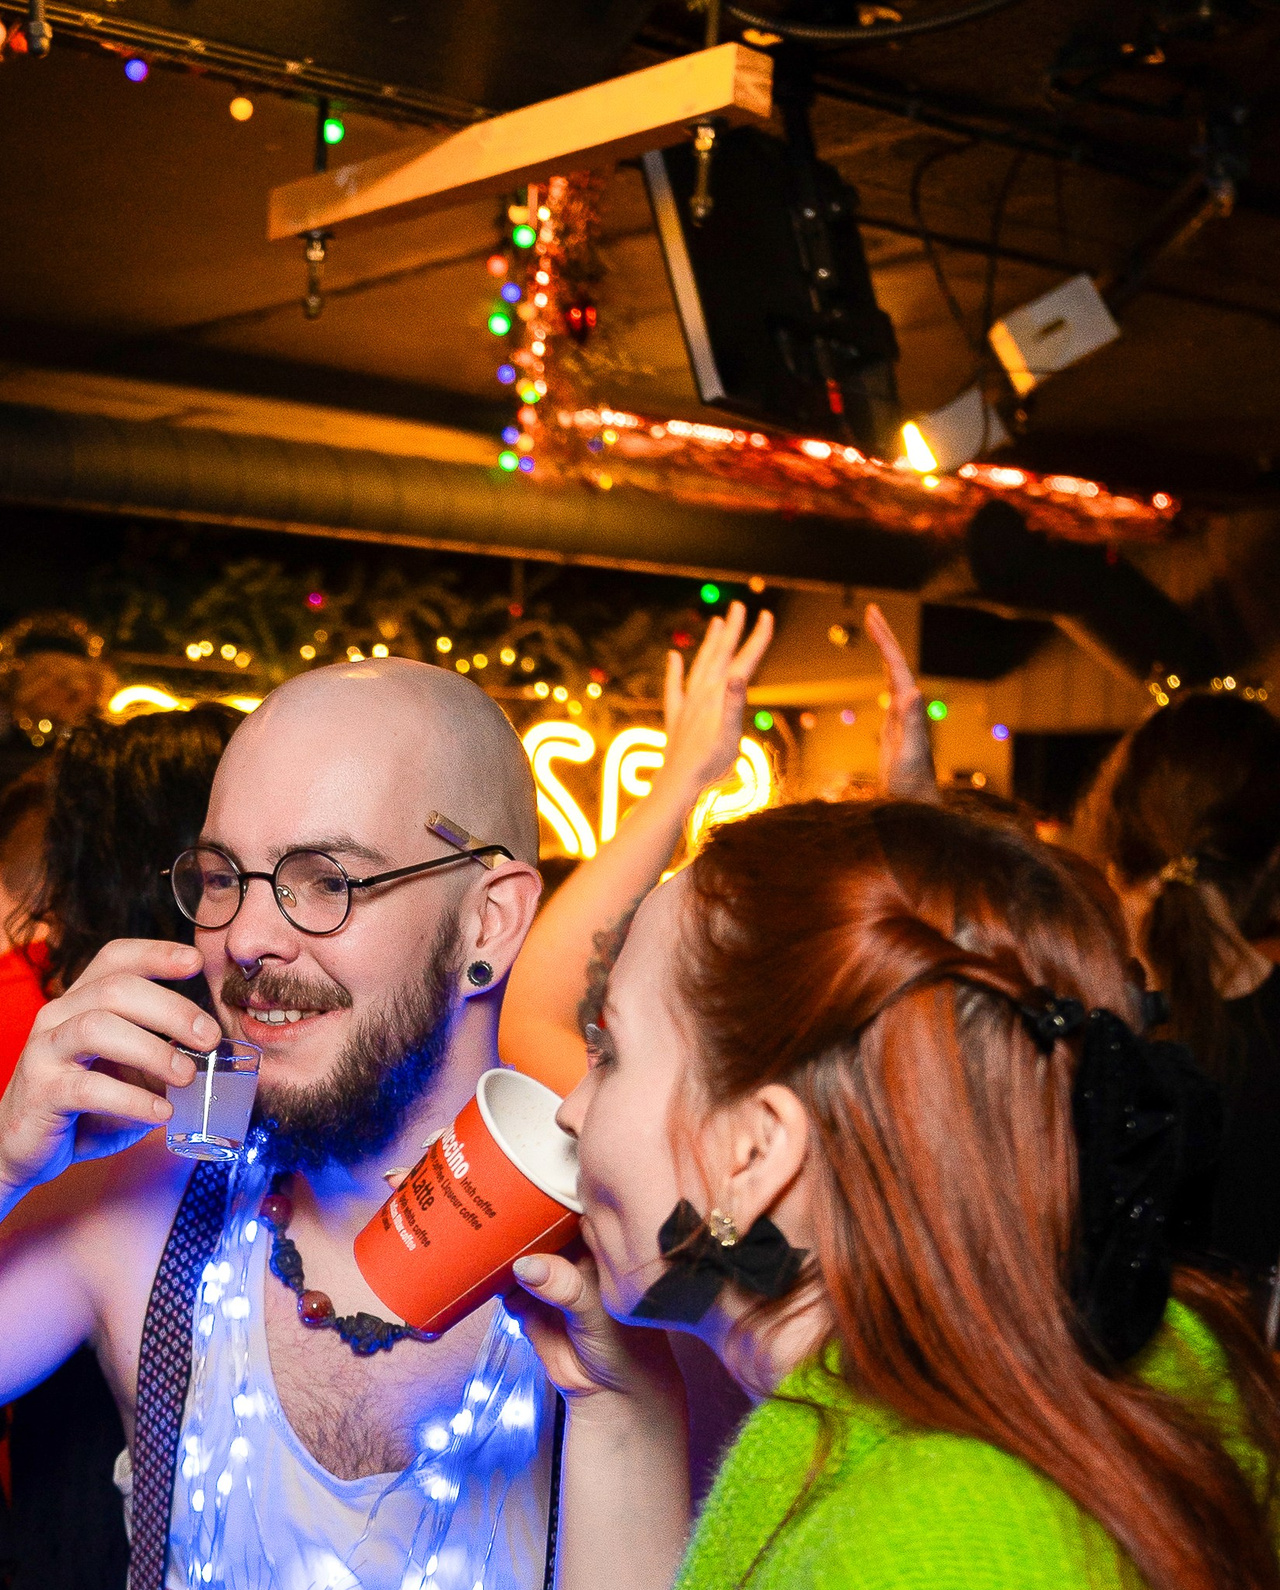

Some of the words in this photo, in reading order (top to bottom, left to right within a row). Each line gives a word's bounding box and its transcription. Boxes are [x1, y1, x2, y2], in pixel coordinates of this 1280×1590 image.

[411, 1168, 435, 1211] Latte
[459, 1177, 477, 1197] Irish
[472, 1195, 497, 1218] coffee
[458, 1207, 483, 1230] coffee
[399, 1229, 417, 1251] coffee
[412, 1223, 431, 1248] coffee
